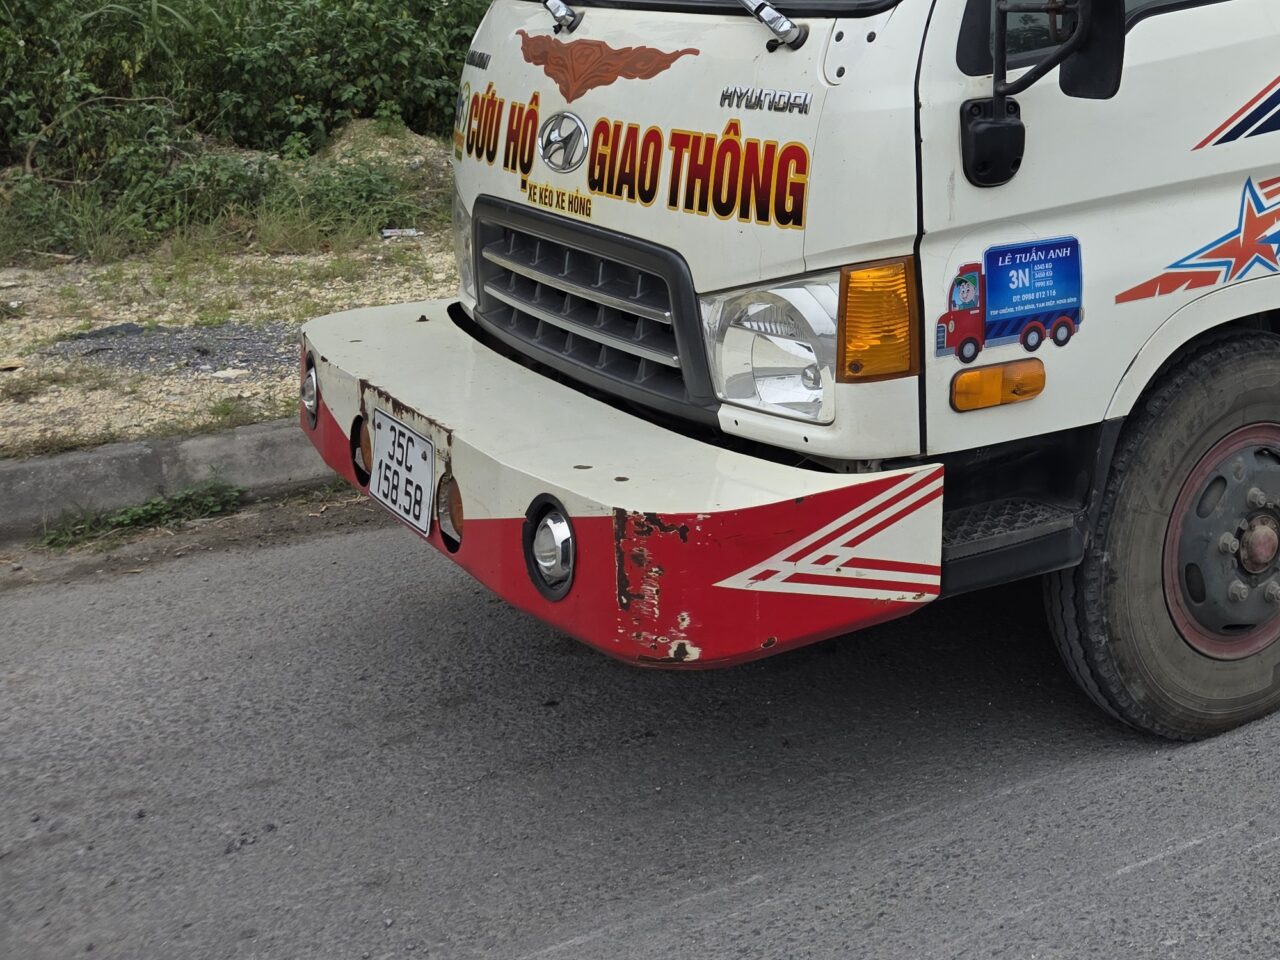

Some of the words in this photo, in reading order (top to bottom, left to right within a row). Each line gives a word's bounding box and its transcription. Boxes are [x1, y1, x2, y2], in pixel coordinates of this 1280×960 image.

[719, 86, 813, 115] HYUNDAI
[466, 81, 505, 166] CỨU
[503, 91, 540, 193] HỘ
[588, 117, 664, 208] GIAO
[667, 118, 810, 230] THÔNG
[527, 183, 538, 203] XE
[538, 184, 554, 208] KÉO
[555, 190, 566, 211] XE
[998, 253, 1012, 266] LÊ
[1015, 247, 1046, 264] TUẤN
[1047, 247, 1071, 260] ANH
[1009, 268, 1030, 289] 3N
[387, 425, 415, 473] 35C
[377, 458, 424, 522] 158.58
